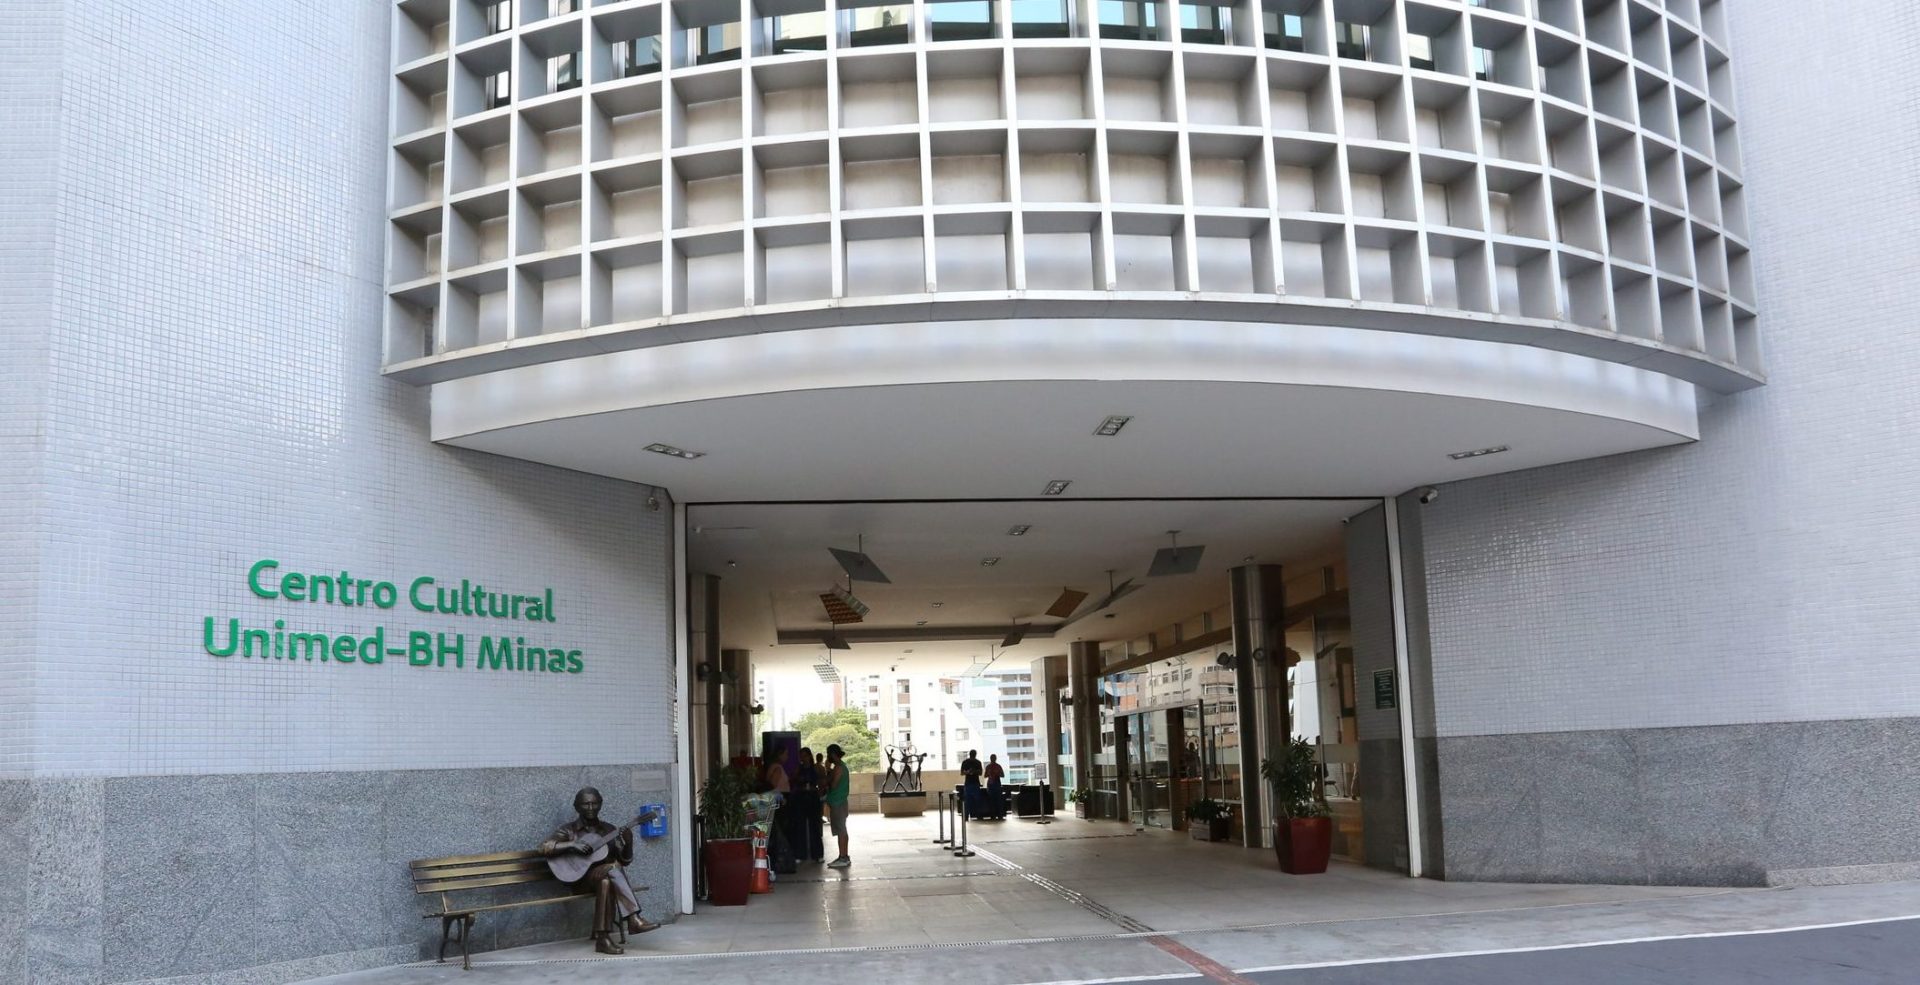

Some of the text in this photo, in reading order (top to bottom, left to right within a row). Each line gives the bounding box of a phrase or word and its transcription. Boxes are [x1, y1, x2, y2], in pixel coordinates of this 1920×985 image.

[248, 559, 556, 622] Centro Cultural
[203, 616, 584, 673] Unimed-BH Minas
